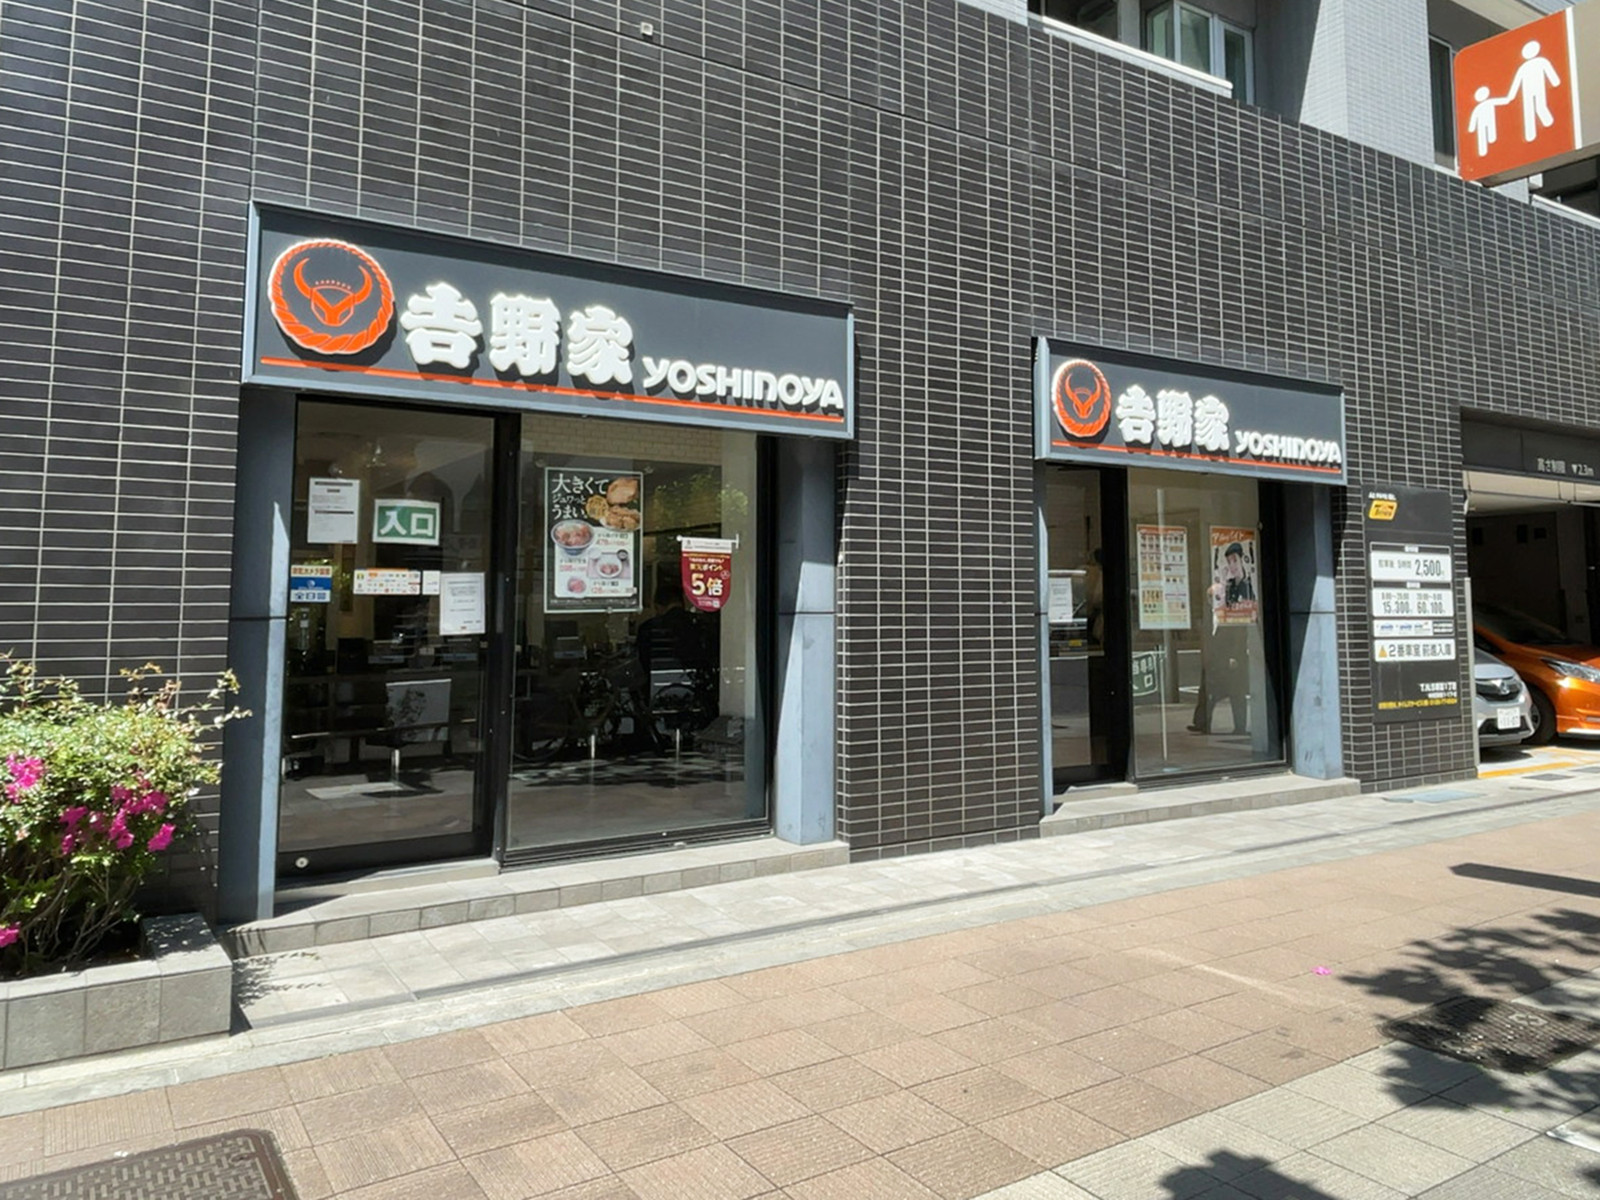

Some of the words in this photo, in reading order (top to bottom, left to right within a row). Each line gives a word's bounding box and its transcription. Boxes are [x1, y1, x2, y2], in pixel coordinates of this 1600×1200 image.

[400, 282, 634, 385] 吉野家
[642, 356, 845, 410] YOSHINOYA
[1115, 384, 1230, 451] 吉野家
[1235, 430, 1342, 463] YOSHINOYA
[552, 473, 609, 494] 大きくて
[380, 511, 434, 536] 入口
[691, 573, 724, 596] 5倍
